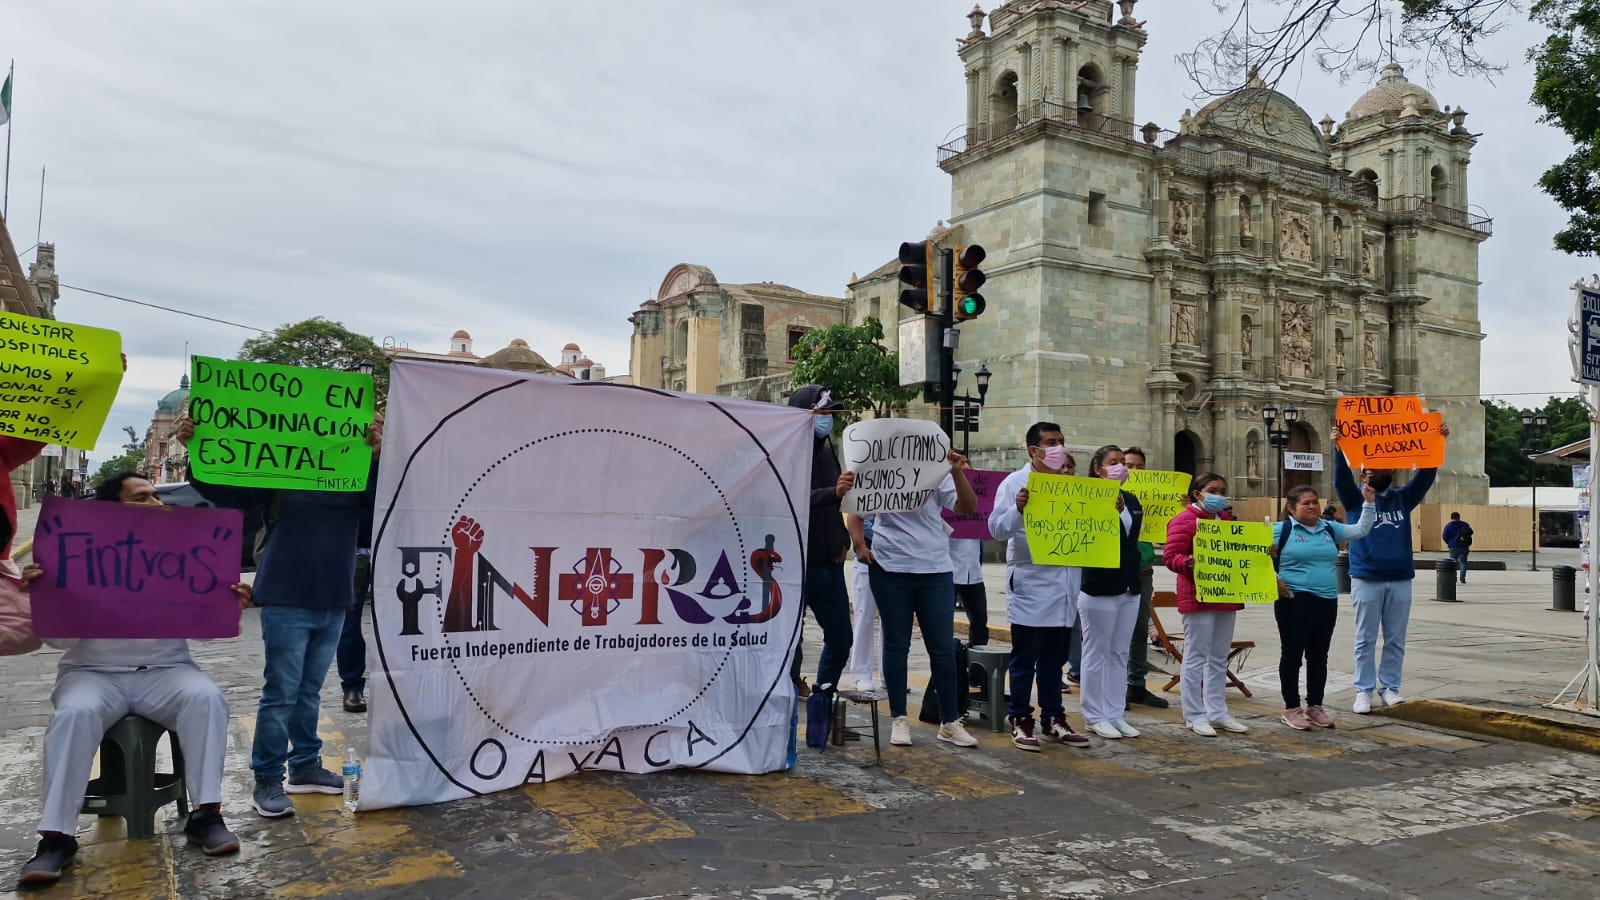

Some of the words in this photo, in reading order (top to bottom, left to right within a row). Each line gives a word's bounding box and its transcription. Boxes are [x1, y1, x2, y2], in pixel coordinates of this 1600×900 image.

[56, 386, 78, 395] DE
[325, 384, 364, 409] EN
[0, 393, 83, 413] CIENTES!
[0, 409, 20, 419] AR
[189, 396, 369, 439] COORDINACIÓN
[849, 428, 947, 464] SOLICITAMOS
[1363, 439, 1427, 457] LABORAL
[316, 476, 363, 490] FINTRAS
[854, 467, 906, 489] NSUMOS
[913, 467, 920, 487] Y
[1056, 517, 1070, 531] de
[1231, 525, 1244, 535] DE
[1210, 539, 1221, 552] DE
[1239, 559, 1251, 569] DE
[1241, 572, 1249, 586] Y
[411, 644, 461, 661] Fuerza
[466, 637, 570, 659] Independiente
[573, 635, 591, 650] de
[594, 633, 688, 651] Trabajadores
[691, 632, 709, 647] de
[713, 632, 726, 647] la
[729, 631, 768, 647] Salud
[469, 719, 718, 785] OAXACA
